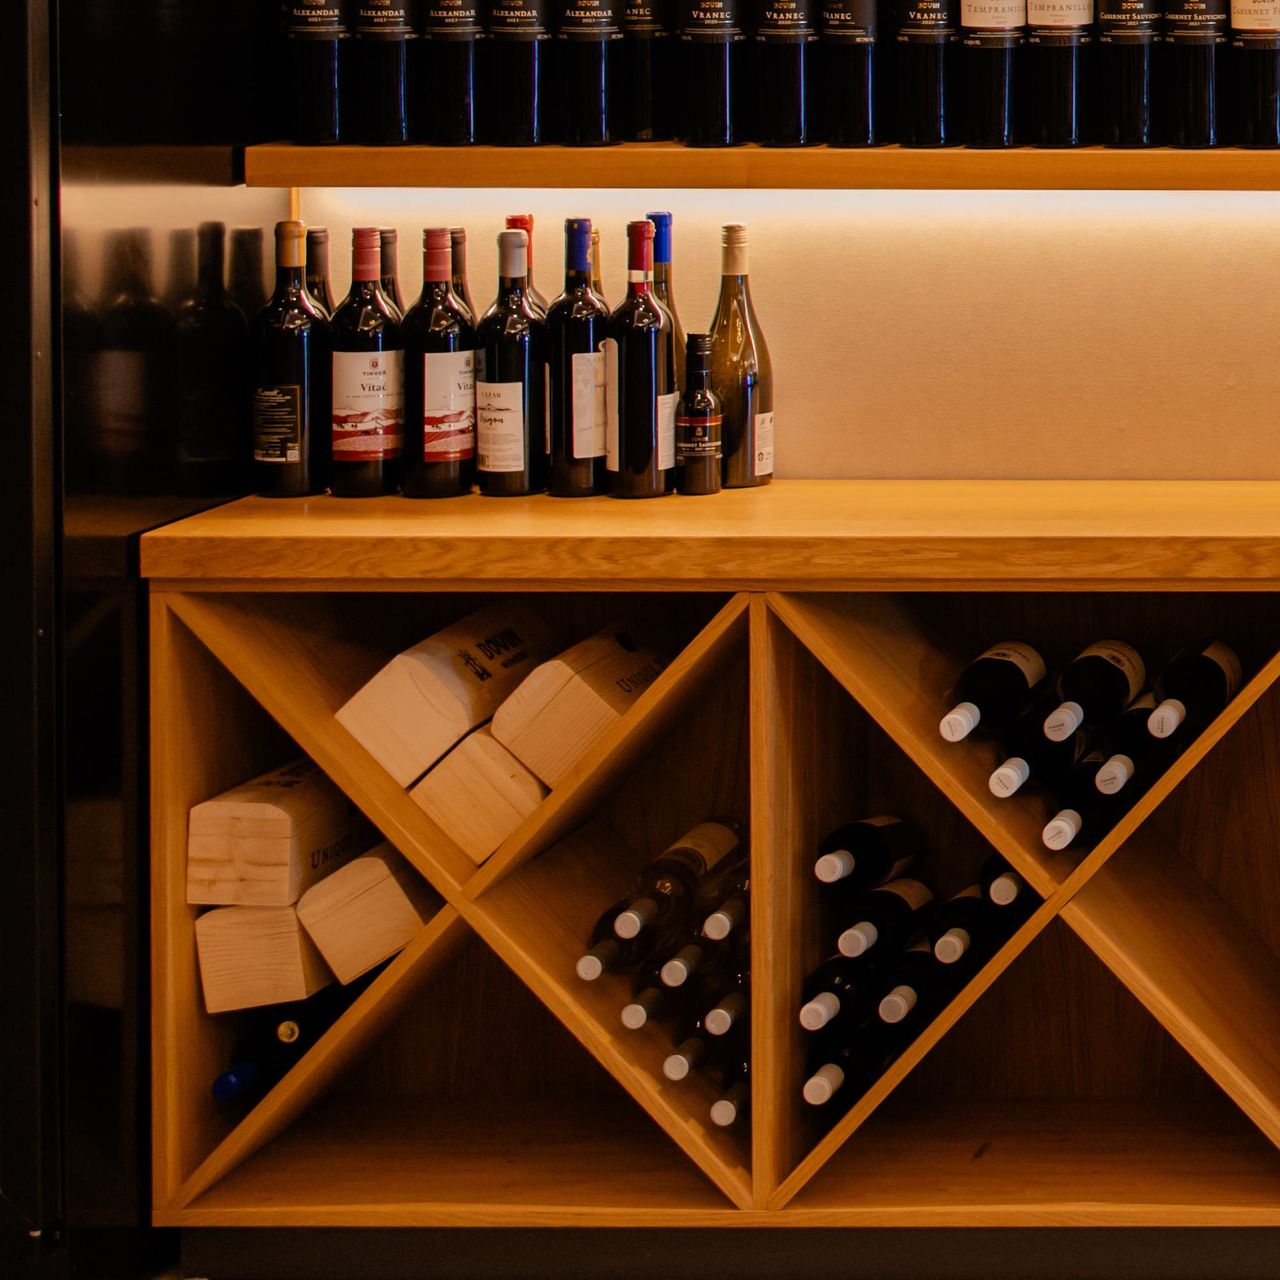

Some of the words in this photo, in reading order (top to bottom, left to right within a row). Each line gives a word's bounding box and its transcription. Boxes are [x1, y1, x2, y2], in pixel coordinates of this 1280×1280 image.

[292, 8, 340, 16] ALEXANDAR
[966, 4, 1026, 13] TEMPRANILL
[359, 9, 406, 17] ALEXANDAR
[429, 9, 476, 17] ALEXANDAR
[492, 9, 538, 17] ALEXANDAR
[565, 9, 613, 17] ALEXANDAR
[692, 11, 731, 19] VRANEC
[766, 11, 805, 19] VRANEC
[909, 11, 948, 20] VRANEC
[457, 382, 473, 391] Vita
